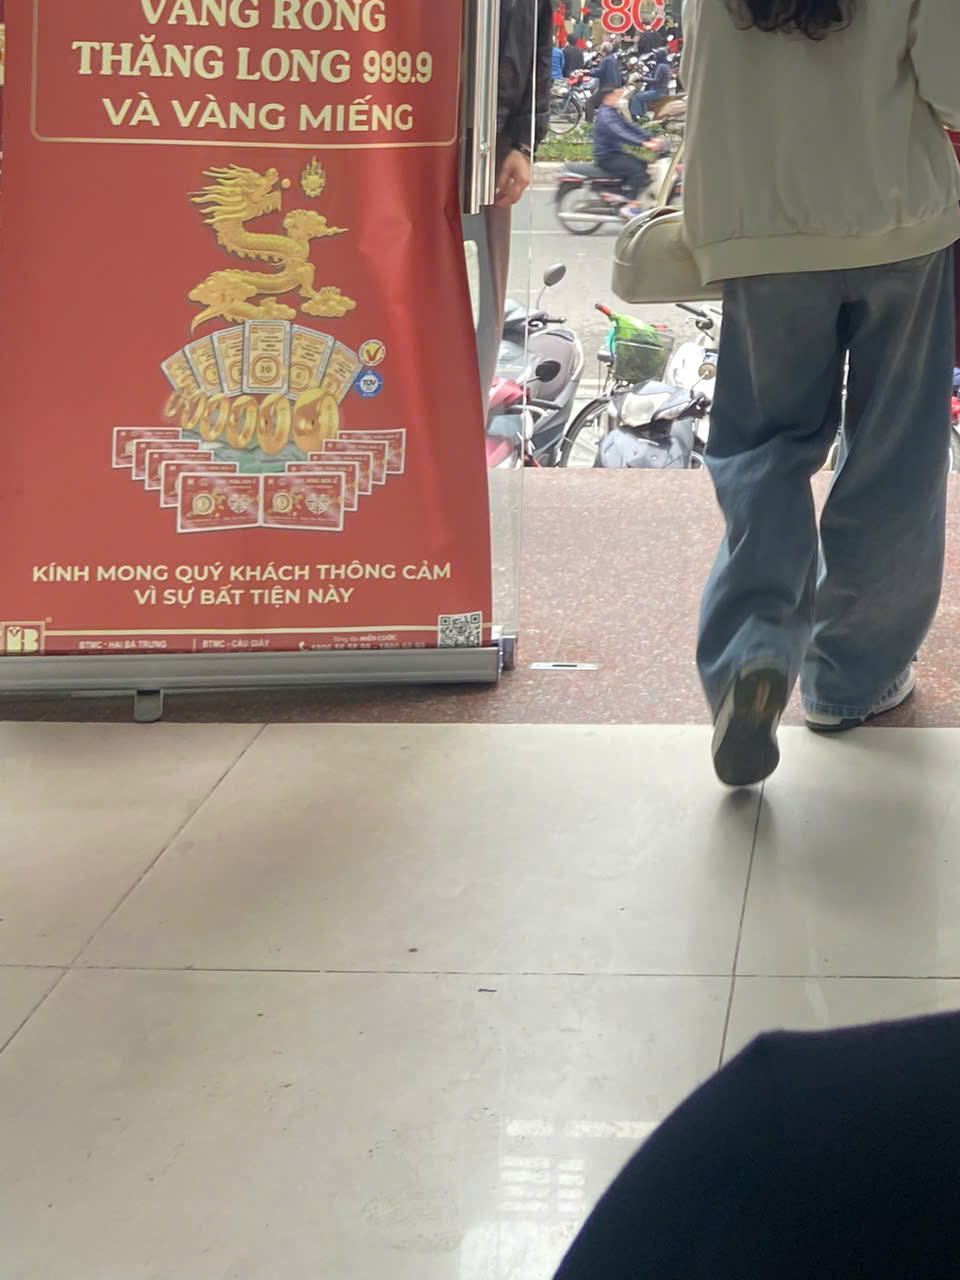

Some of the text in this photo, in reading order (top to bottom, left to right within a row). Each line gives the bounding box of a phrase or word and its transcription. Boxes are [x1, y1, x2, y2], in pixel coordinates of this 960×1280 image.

[72, 34, 432, 83] THĂNG LONG 999.9
[102, 92, 413, 131] VÀ VÀNG MIẾNG
[32, 560, 450, 583] KÍNH MONG QUÝ KHÁCH THÔNG CẢM
[134, 584, 354, 608] VÌ SỰ BẤT TIỆN NÀY
